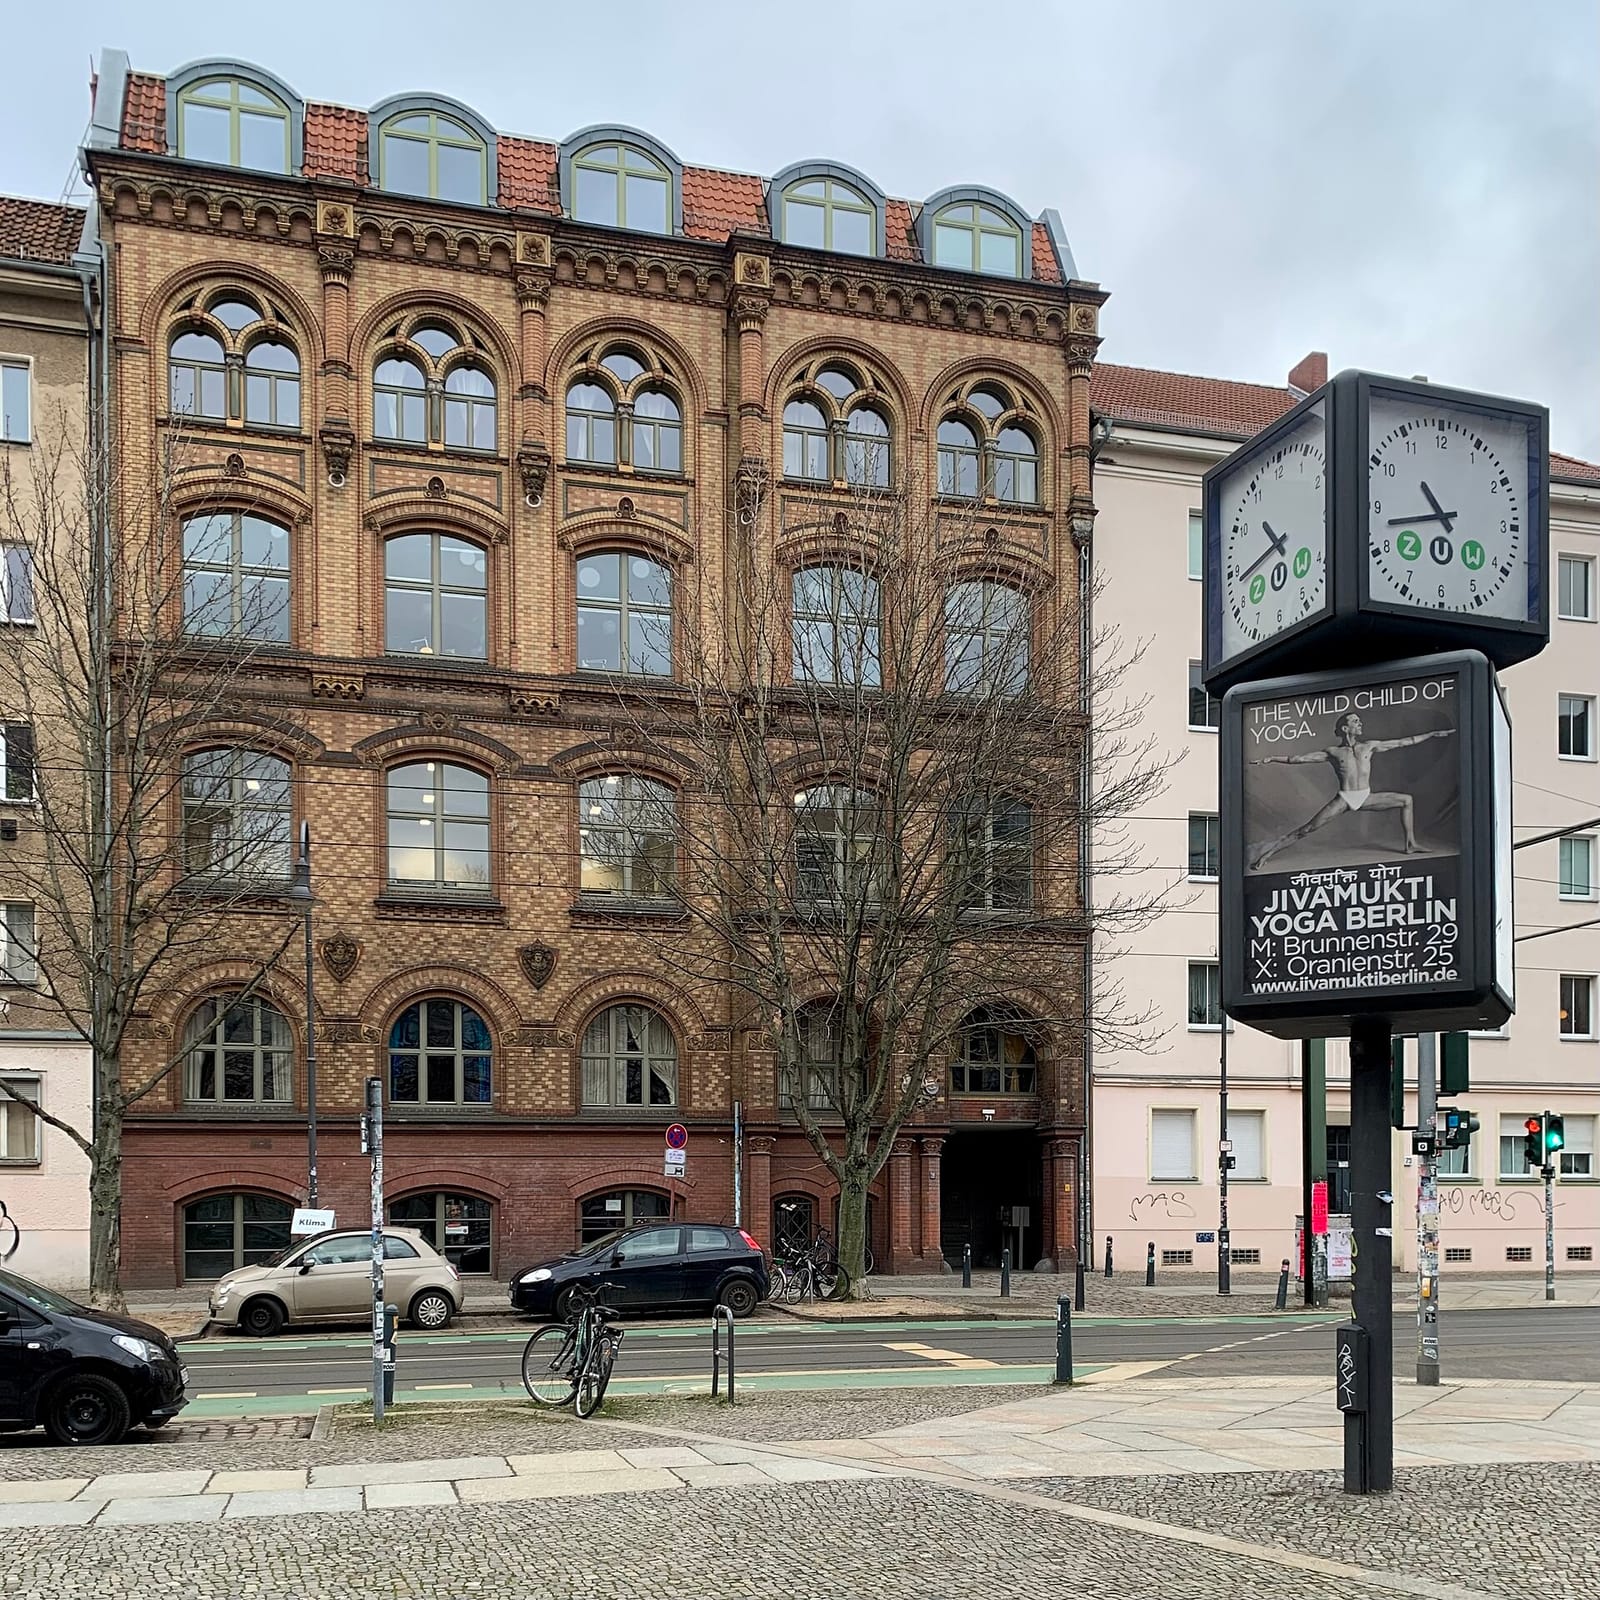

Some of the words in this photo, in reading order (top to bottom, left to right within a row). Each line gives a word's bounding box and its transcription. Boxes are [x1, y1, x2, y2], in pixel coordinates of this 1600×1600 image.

[1406, 441, 1416, 455] 11
[1435, 435, 1447, 449] 12
[1274, 465, 1284, 481] 12
[1383, 463, 1395, 477] 10
[1314, 475, 1321, 490] 2
[1490, 480, 1497, 494] 2
[1254, 489, 1262, 504] 11
[1374, 501, 1381, 514] 9
[1240, 523, 1249, 538] 10
[1500, 520, 1507, 533] 3
[1383, 540, 1390, 553] 8
[1316, 551, 1322, 564] 4
[1491, 556, 1498, 569] 4
[1235, 564, 1240, 578] 9
[1406, 570, 1413, 583] 7
[1438, 584, 1445, 598] 6
[1470, 579, 1477, 592] 5
[1299, 587, 1305, 601] 5
[1240, 595, 1246, 609] 8
[1255, 612, 1261, 625] 7
[1277, 609, 1282, 623] 6
[1250, 702, 1291, 724] THE
[1294, 695, 1350, 718] WILD
[1354, 685, 1418, 710] CHILD
[1422, 679, 1455, 700] OF
[1250, 721, 1316, 744] YOGA.
[1368, 863, 1402, 880] योग
[1263, 875, 1433, 913] JIVAMUKTI
[1250, 909, 1339, 938] YOGA
[1346, 898, 1457, 931] BERLIN
[1251, 937, 1277, 958] M:
[1284, 928, 1420, 956] Brunnenstr.
[1426, 922, 1459, 945] 29
[1255, 958, 1278, 979] X:
[1287, 949, 1416, 976] Oranienstr.
[1422, 945, 1454, 967] 25
